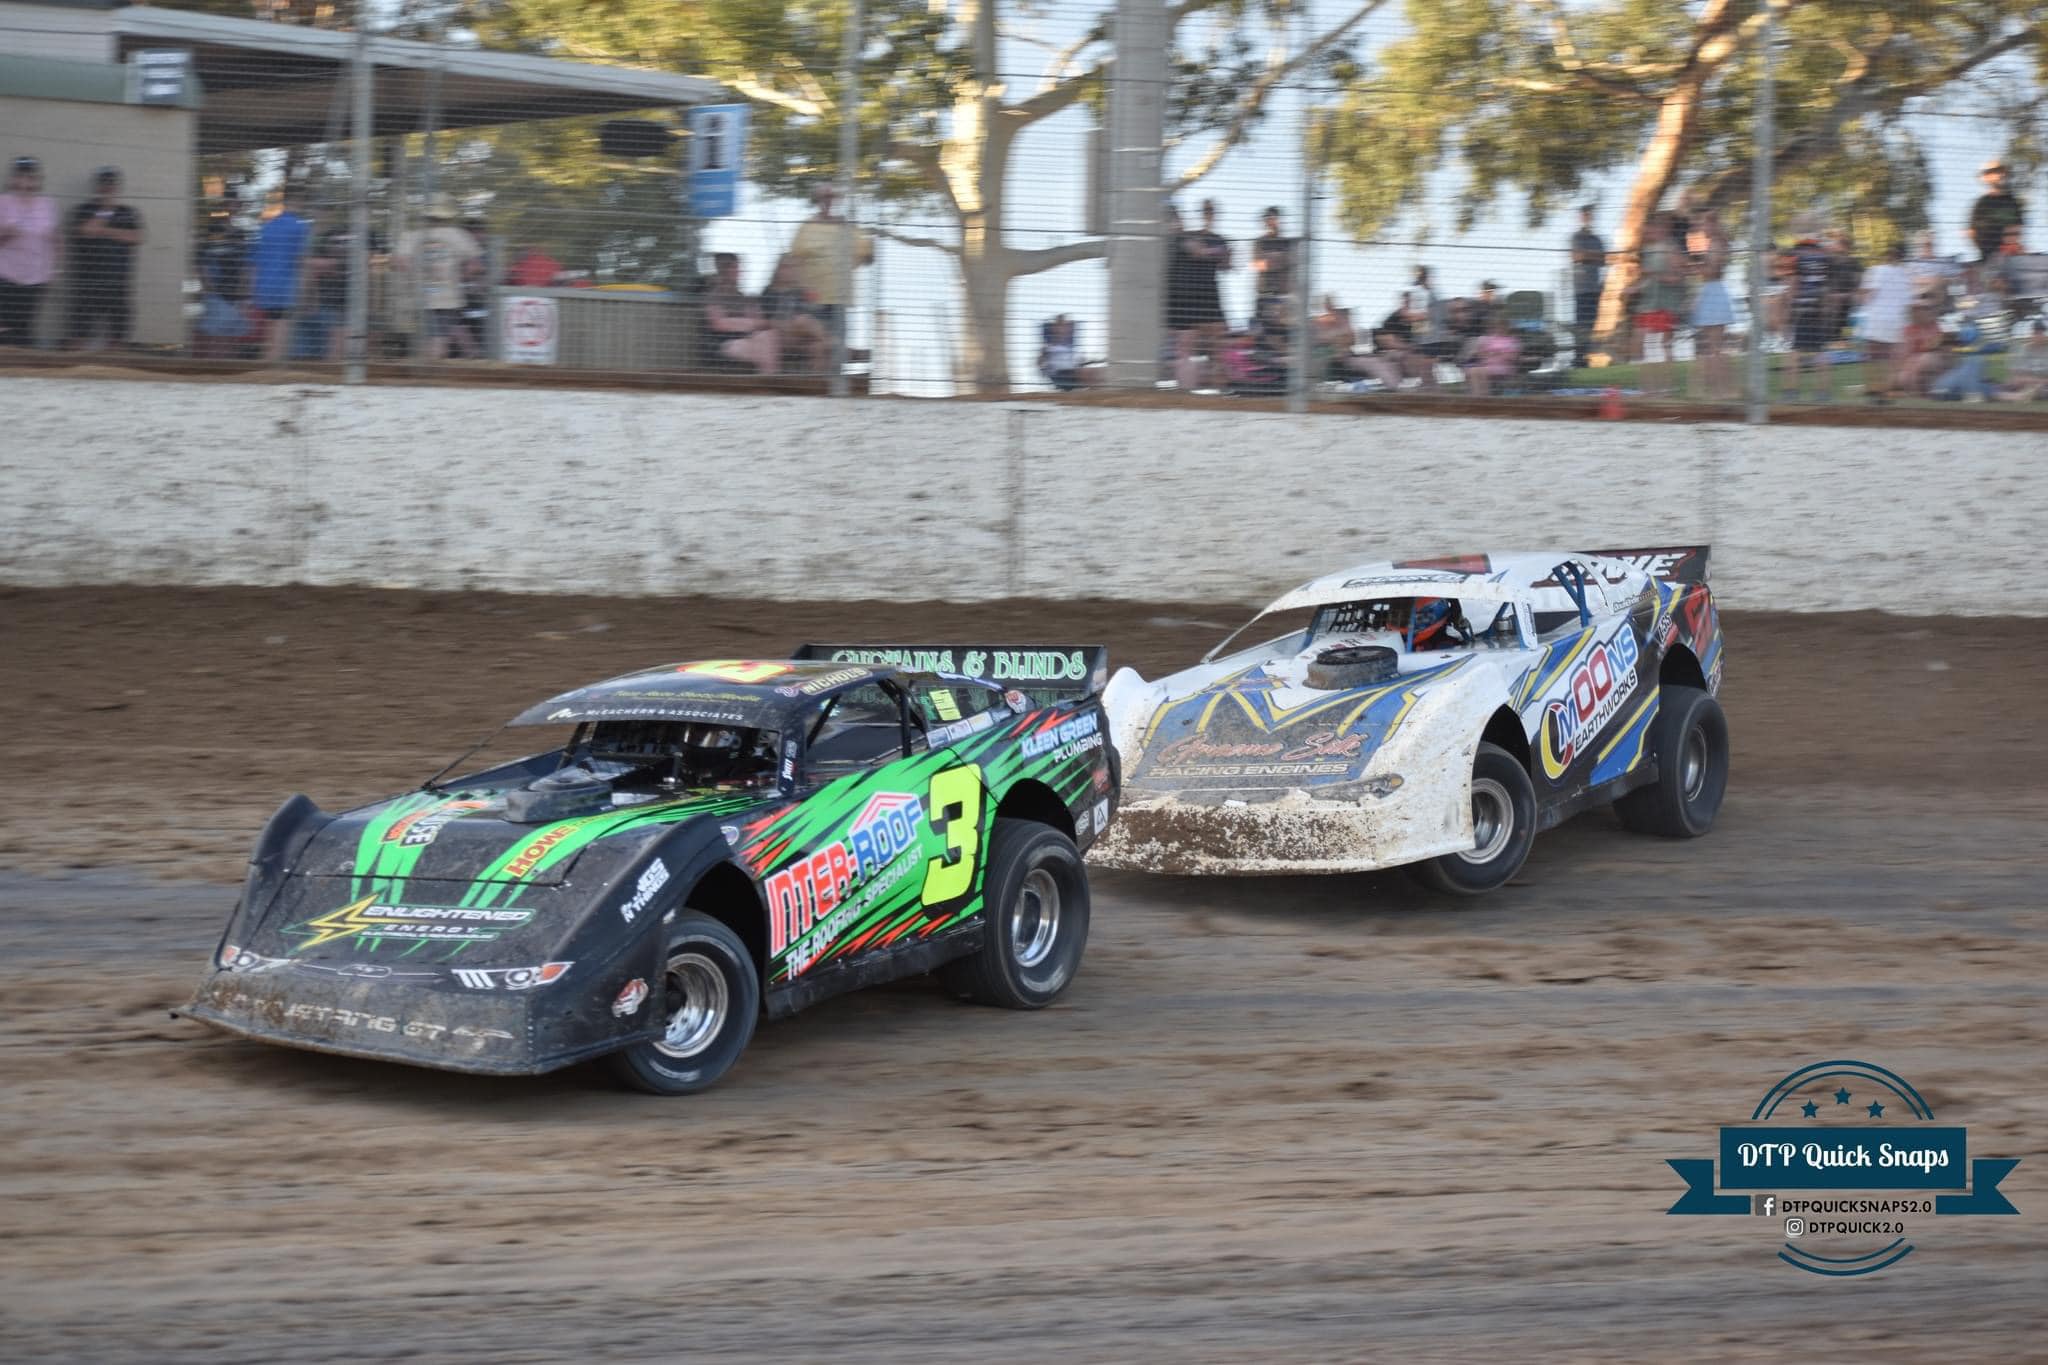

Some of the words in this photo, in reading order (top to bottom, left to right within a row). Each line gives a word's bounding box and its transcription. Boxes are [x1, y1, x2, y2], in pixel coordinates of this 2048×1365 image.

[802, 666, 867, 693] NICHOLS
[963, 650, 987, 679] &
[993, 650, 1087, 681] BLINDS
[1555, 623, 1638, 752] MOONS
[668, 708, 744, 721] ASSOCIATES
[1573, 667, 1637, 751] EARTHWORKS
[1060, 711, 1098, 743] GREEN
[1053, 731, 1104, 763] PLUMBING
[1149, 765, 1240, 777] RACING
[1243, 763, 1349, 776] ENGINES
[921, 763, 982, 907] 3
[504, 825, 579, 877] HOWE
[362, 905, 532, 921] ENLIGHTENED
[786, 938, 811, 980] THE
[863, 842, 923, 908] SPECIALIST
[383, 923, 480, 935] ENERGY
[403, 1020, 447, 1040] GT
